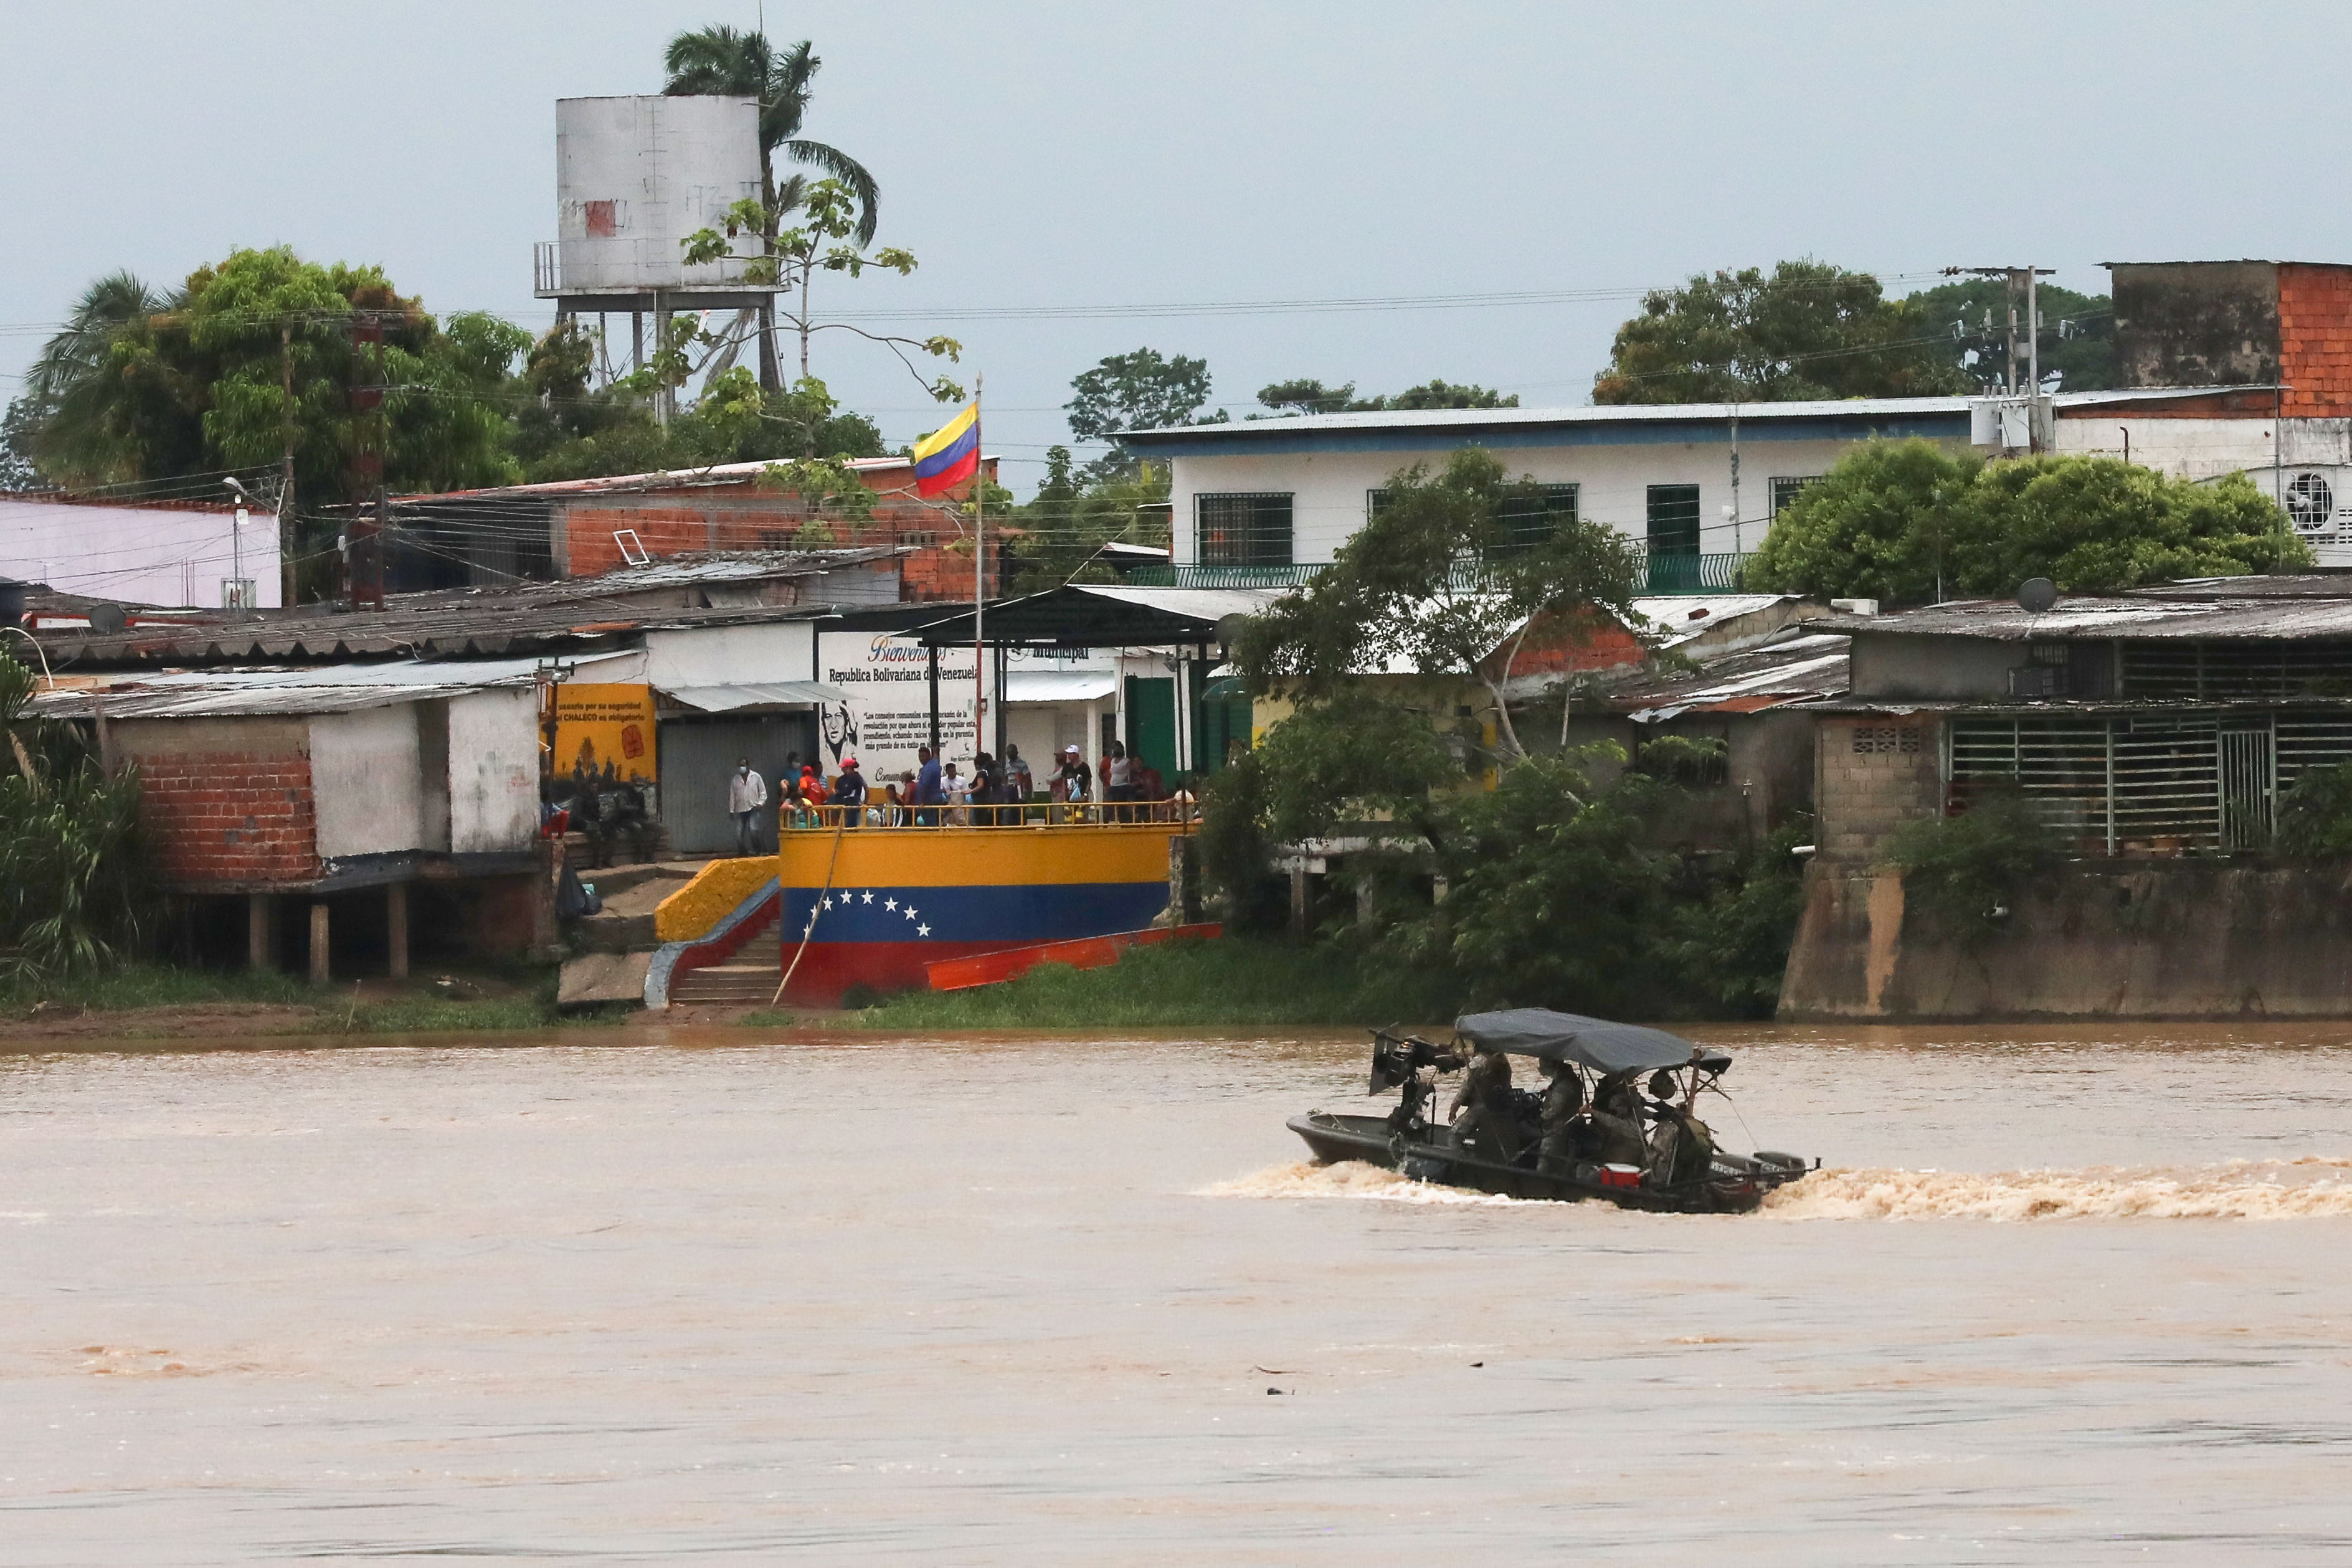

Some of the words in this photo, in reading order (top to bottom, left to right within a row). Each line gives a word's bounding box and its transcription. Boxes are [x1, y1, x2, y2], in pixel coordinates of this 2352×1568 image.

[868, 635, 946, 662] Bienvenios
[1033, 648, 1089, 664] Municipal
[829, 667, 871, 686] Republica
[873, 667, 921, 682] Bolivariana
[924, 666, 930, 681] d
[586, 703, 596, 711] por
[608, 701, 641, 711] seguridad
[609, 713, 645, 724] obligatorio
[875, 712, 895, 721] consejos
[889, 723, 898, 731] por
